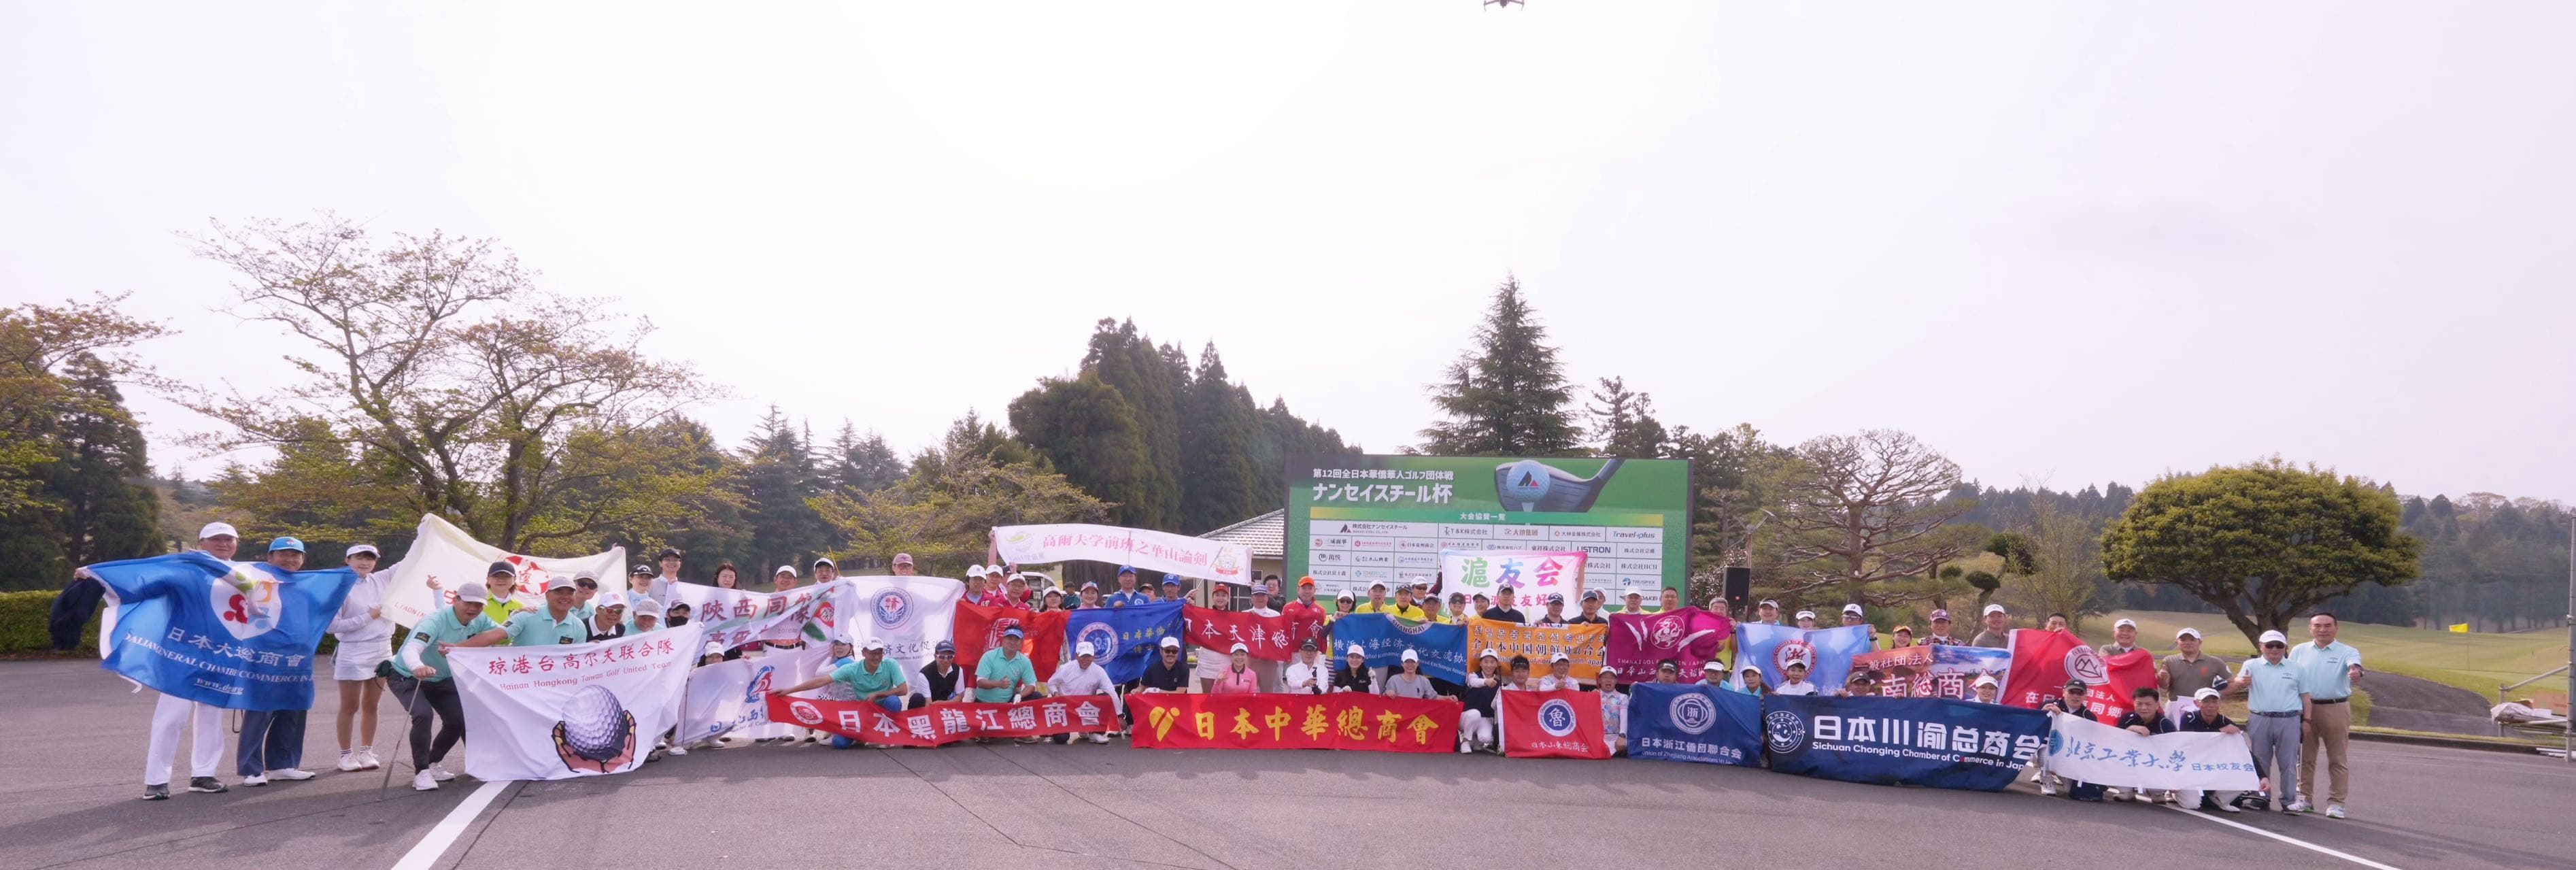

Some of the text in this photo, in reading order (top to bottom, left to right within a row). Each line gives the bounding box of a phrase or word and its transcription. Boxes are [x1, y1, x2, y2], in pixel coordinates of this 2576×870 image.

[1312, 482, 1453, 504] ナンセイスチール杯
[1459, 513, 1506, 521] 大会協賛一覧
[1392, 619, 1425, 634] SHANGHAI
[1854, 652, 1934, 671] 一般社団法人
[500, 682, 529, 692] Hainan
[534, 677, 578, 689] Hongkong
[606, 668, 621, 678] Golf
[624, 665, 647, 674] United
[1195, 704, 1440, 745] 日本中華總商會
[1663, 751, 1687, 761] Zhejiang
[1812, 741, 1851, 753] Sichuan
[1852, 744, 1901, 758] Chonging
[1902, 748, 1941, 761] Chamber
[1941, 752, 1951, 763] of
[1996, 758, 2004, 767] in
[2005, 760, 2024, 772] Jap
[2191, 762, 2255, 772] 日本校友会
